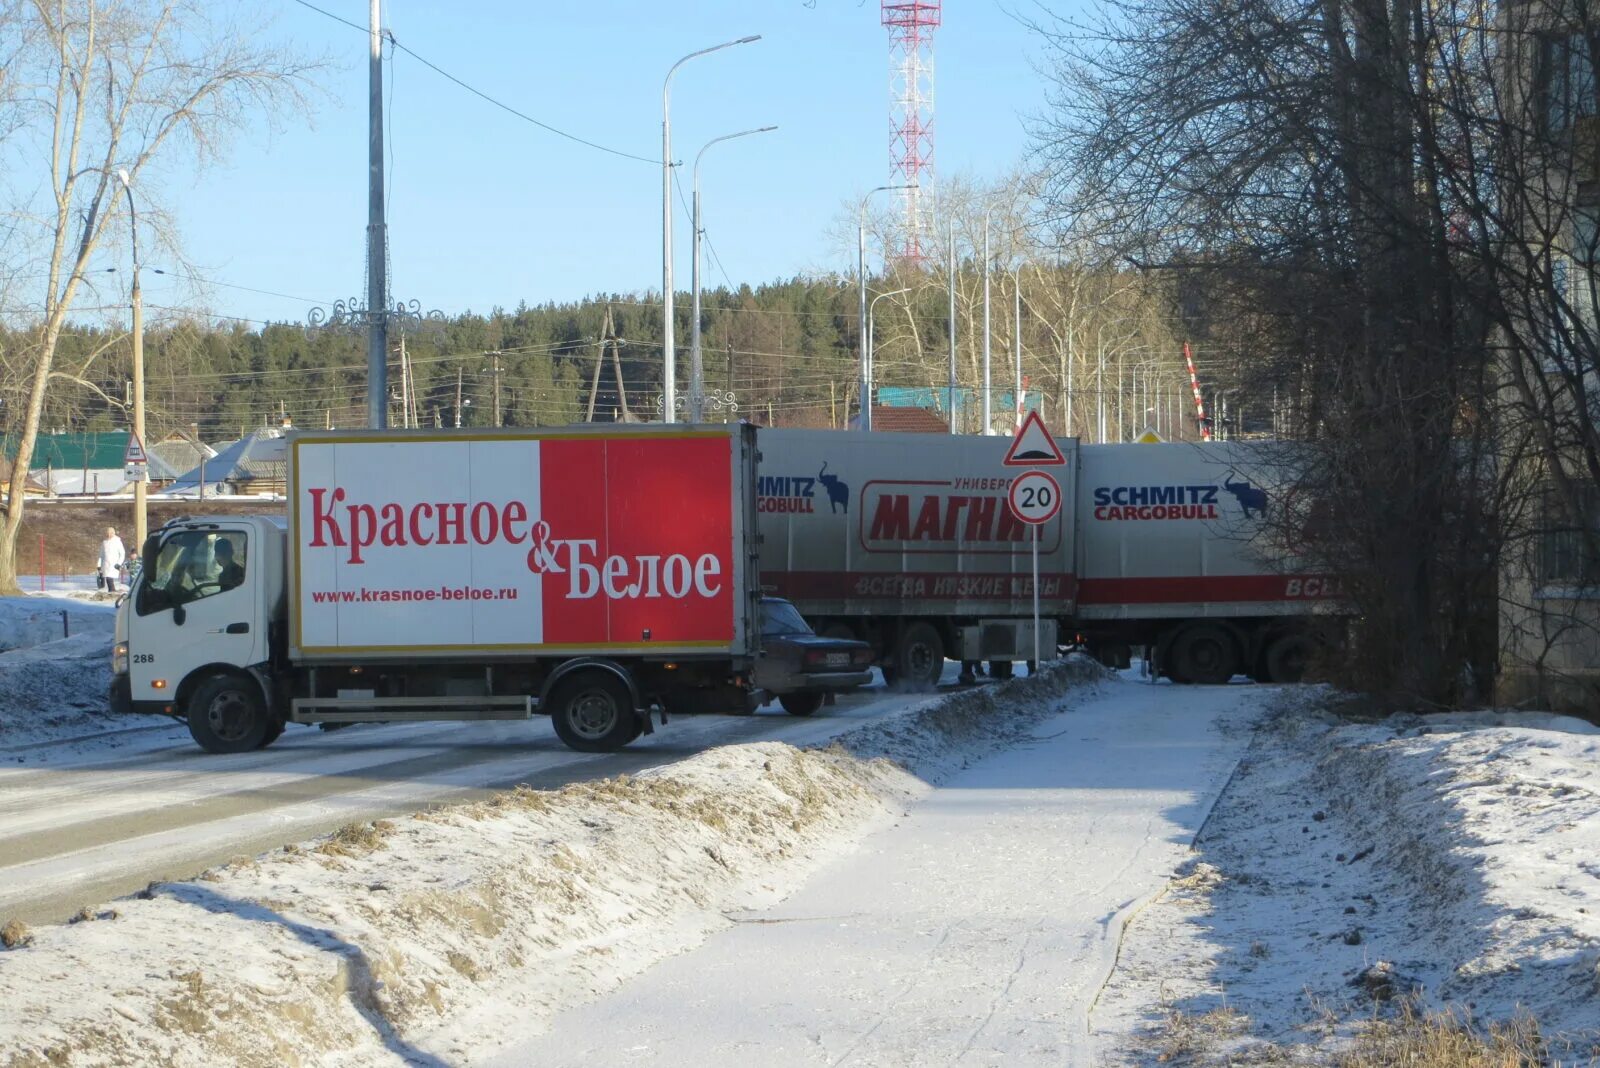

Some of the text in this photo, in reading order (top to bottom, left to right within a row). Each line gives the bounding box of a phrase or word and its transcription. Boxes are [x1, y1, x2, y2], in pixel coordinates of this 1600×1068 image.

[1021, 486, 1052, 508] 20
[1093, 486, 1218, 506] SCHMITZ
[1093, 504, 1218, 521] CARGOBULL
[308, 487, 527, 564] Красное
[560, 539, 721, 600] Белое
[313, 586, 518, 602] www.krasnoe-beloe.ru
[855, 575, 926, 597] ВСЕГДА
[133, 654, 154, 663] 288
